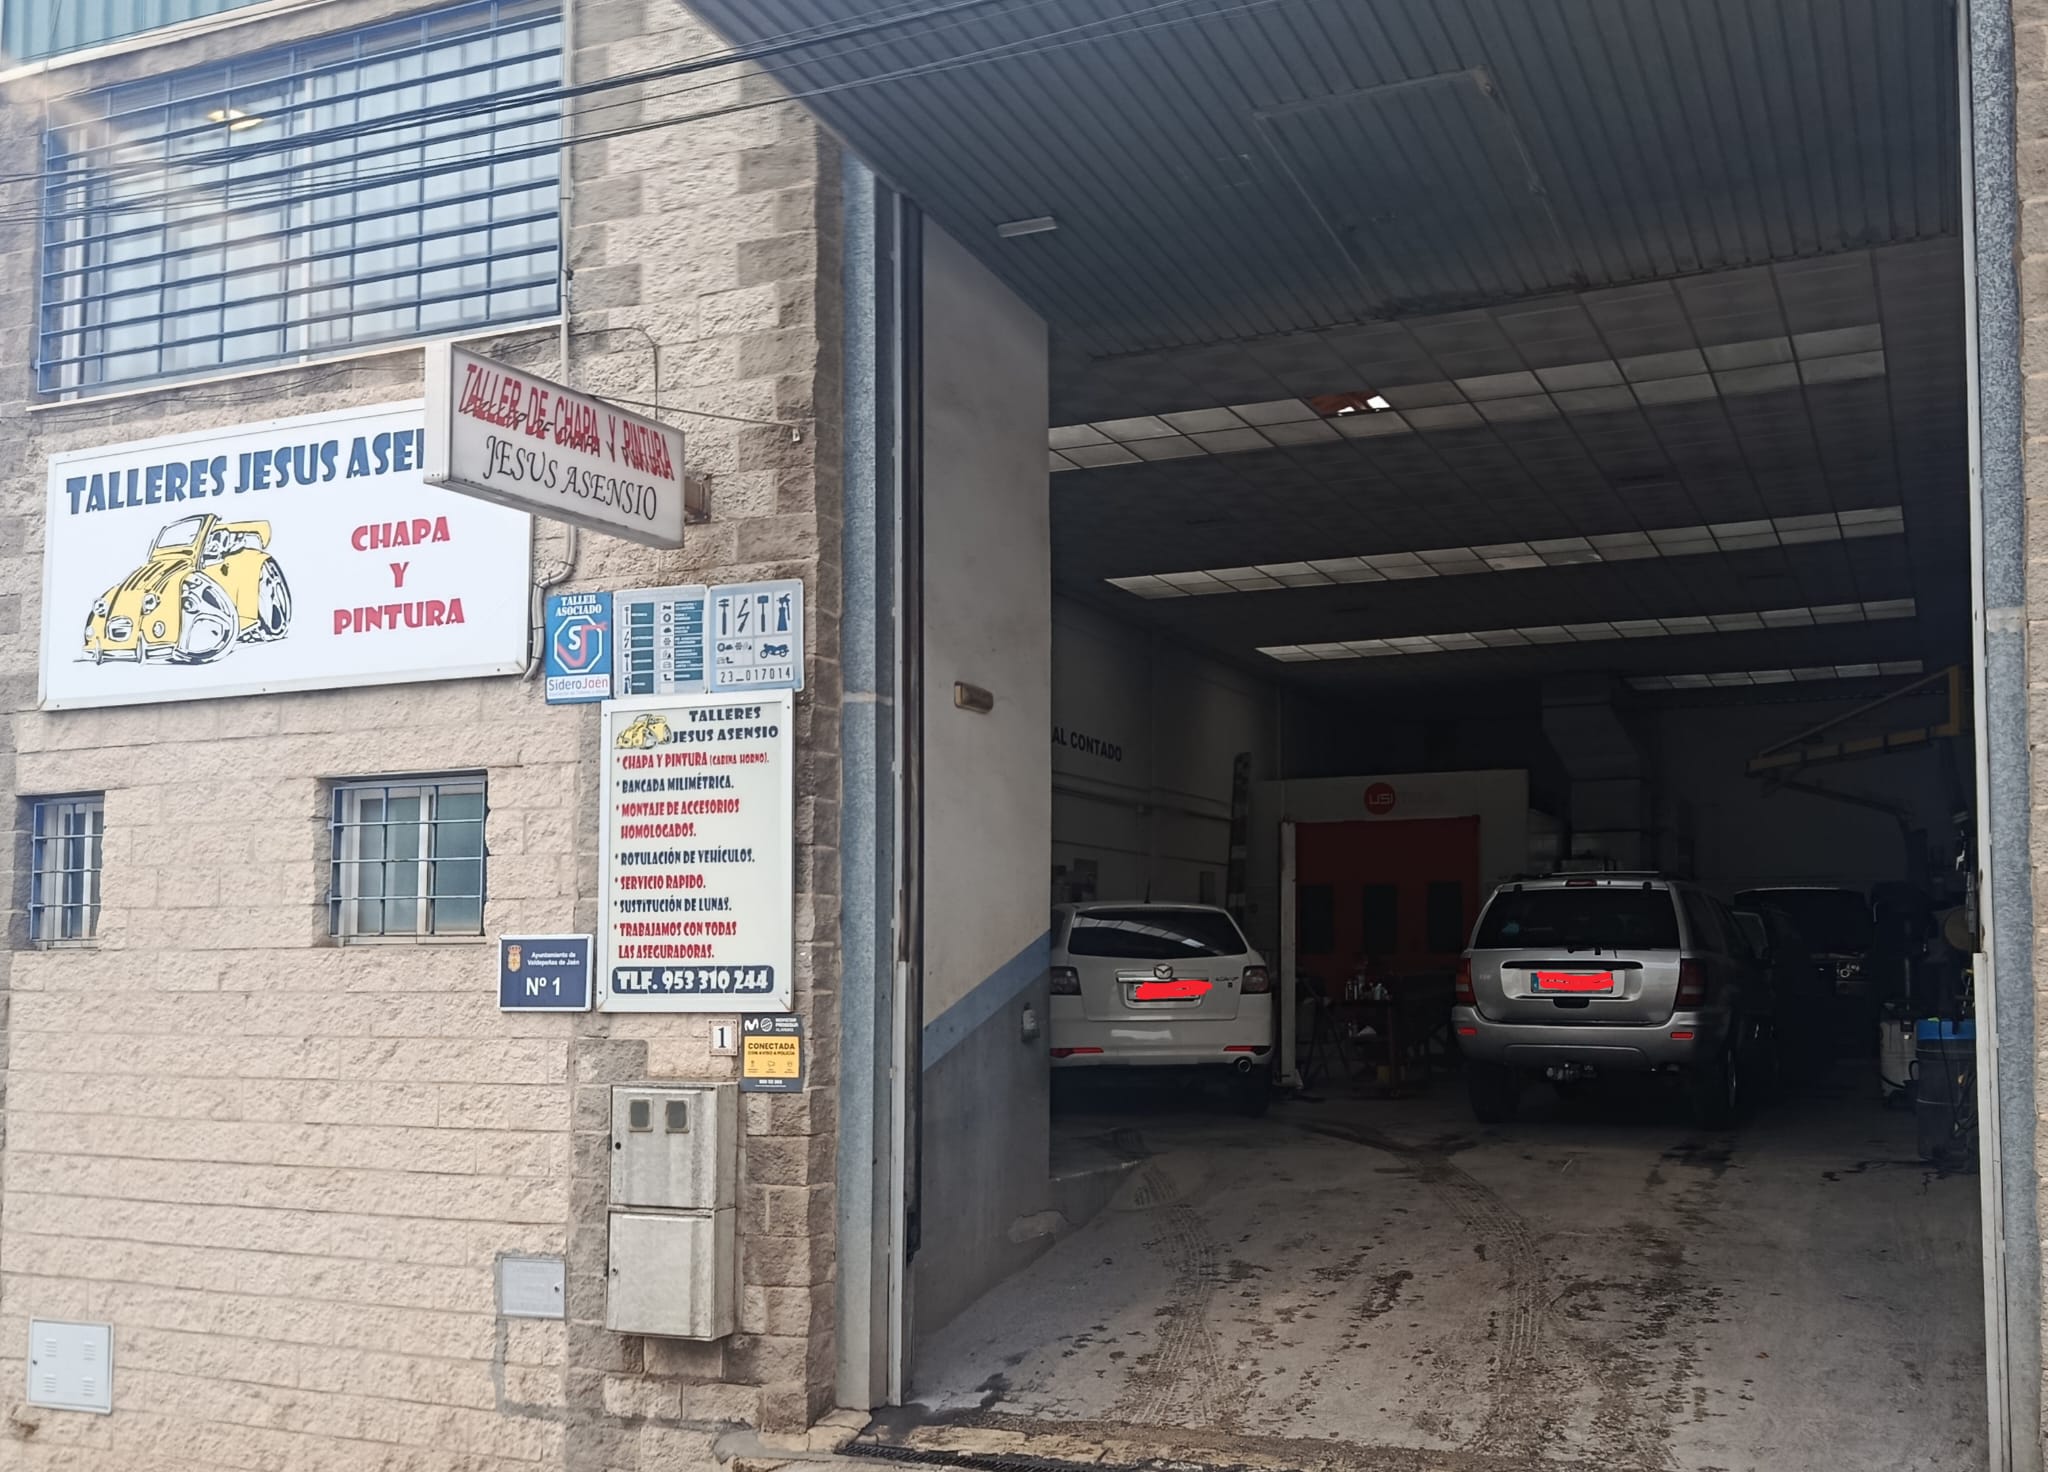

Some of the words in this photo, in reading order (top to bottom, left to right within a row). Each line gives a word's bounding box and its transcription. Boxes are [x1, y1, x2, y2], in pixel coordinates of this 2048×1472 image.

[458, 363, 522, 431] TALLER
[525, 386, 549, 440] DE
[554, 396, 600, 458] CHAPA
[607, 414, 616, 463] Y
[622, 420, 675, 481] PINTURA
[66, 455, 227, 515] TALLERES
[234, 439, 338, 493] JESUS
[483, 435, 558, 489] JESUS
[560, 466, 657, 521] ASENSIO
[351, 516, 450, 551] CHAPA
[389, 561, 410, 588] Y
[561, 595, 597, 606] TALLER
[333, 598, 465, 635] PINTURA
[556, 604, 603, 617] ASOCIADO
[689, 706, 761, 722] TALLERES
[671, 728, 714, 744] JESUS
[717, 725, 779, 741] ASENSIO
[1052, 726, 1067, 746] AL
[1070, 731, 1122, 762] CONTADO
[622, 754, 654, 770] CHAPA
[656, 753, 664, 768] Y
[665, 752, 708, 768] PINTURA
[622, 778, 665, 793] BANCADA
[667, 772, 734, 791] MILIMÉTRICA.
[621, 802, 664, 817] MONTAJE
[666, 801, 678, 815] DE
[681, 798, 740, 814] ACCESORIOS
[621, 822, 697, 839] HOMOLOGADOS.
[621, 847, 681, 866] ROTULACIÓN
[683, 850, 695, 864] DE
[698, 846, 755, 863] VEHÍCULOS.
[620, 875, 663, 890] SERVICIO
[666, 874, 706, 889] RAPIDO.
[620, 895, 682, 913] SUSTITUCIÓN
[684, 898, 697, 912] DE
[699, 897, 732, 911] LUNAS.
[620, 921, 681, 937] TRABAJAMOS
[683, 922, 703, 936] CON
[705, 921, 737, 935] TODAS
[618, 945, 634, 959] LAS
[636, 944, 715, 959] ASEGURADORAS.
[552, 977, 560, 996] 1
[616, 970, 658, 991] TLF.
[662, 969, 695, 990] 953
[699, 969, 730, 990] 310
[733, 969, 769, 990] 244
[718, 1027, 726, 1048] 1
[748, 1042, 795, 1050] CONECTADA
